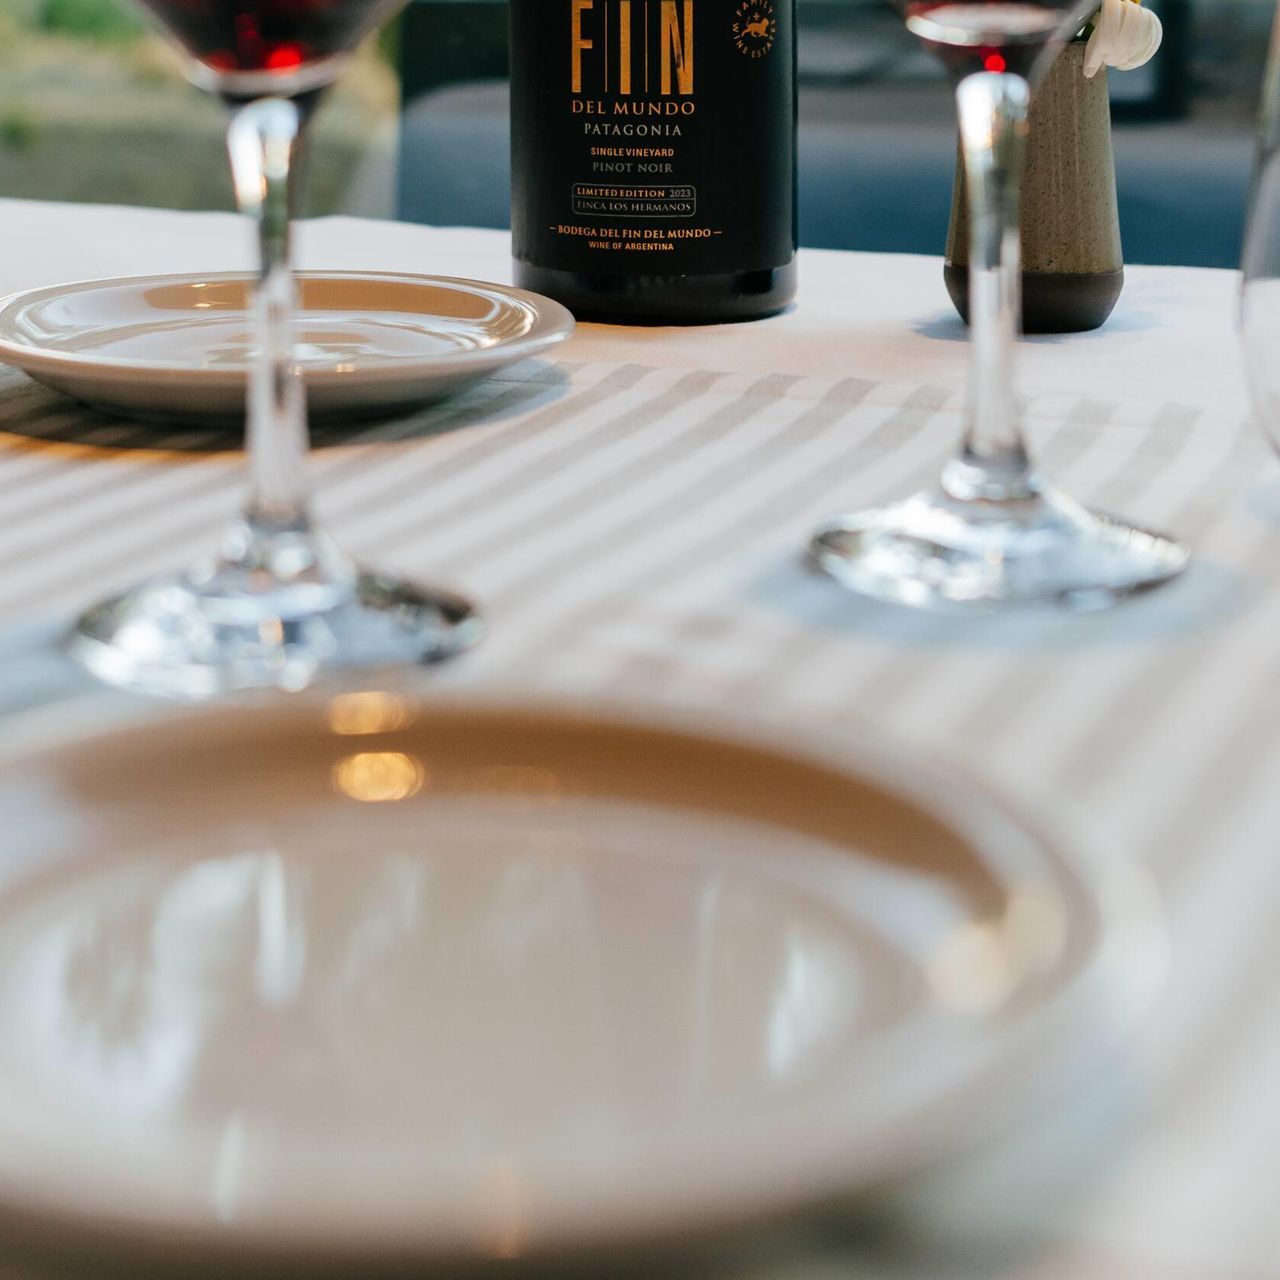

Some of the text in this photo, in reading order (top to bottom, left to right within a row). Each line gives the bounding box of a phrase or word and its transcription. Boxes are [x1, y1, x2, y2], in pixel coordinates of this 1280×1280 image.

[572, 100, 696, 116] DEL MUNDO
[584, 123, 682, 136] PATAGONIA
[590, 147, 674, 158] SINGLE VINEYARD
[593, 161, 673, 174] PINOT NOIR
[577, 187, 617, 197] LIMITED
[619, 188, 665, 198] EDITION
[577, 200, 692, 212] FINCA LOS HERMANOS
[558, 224, 711, 239] BODEGA DEL FIN DEL MUNDO
[589, 241, 674, 251] WINE OF ARGENTINA
